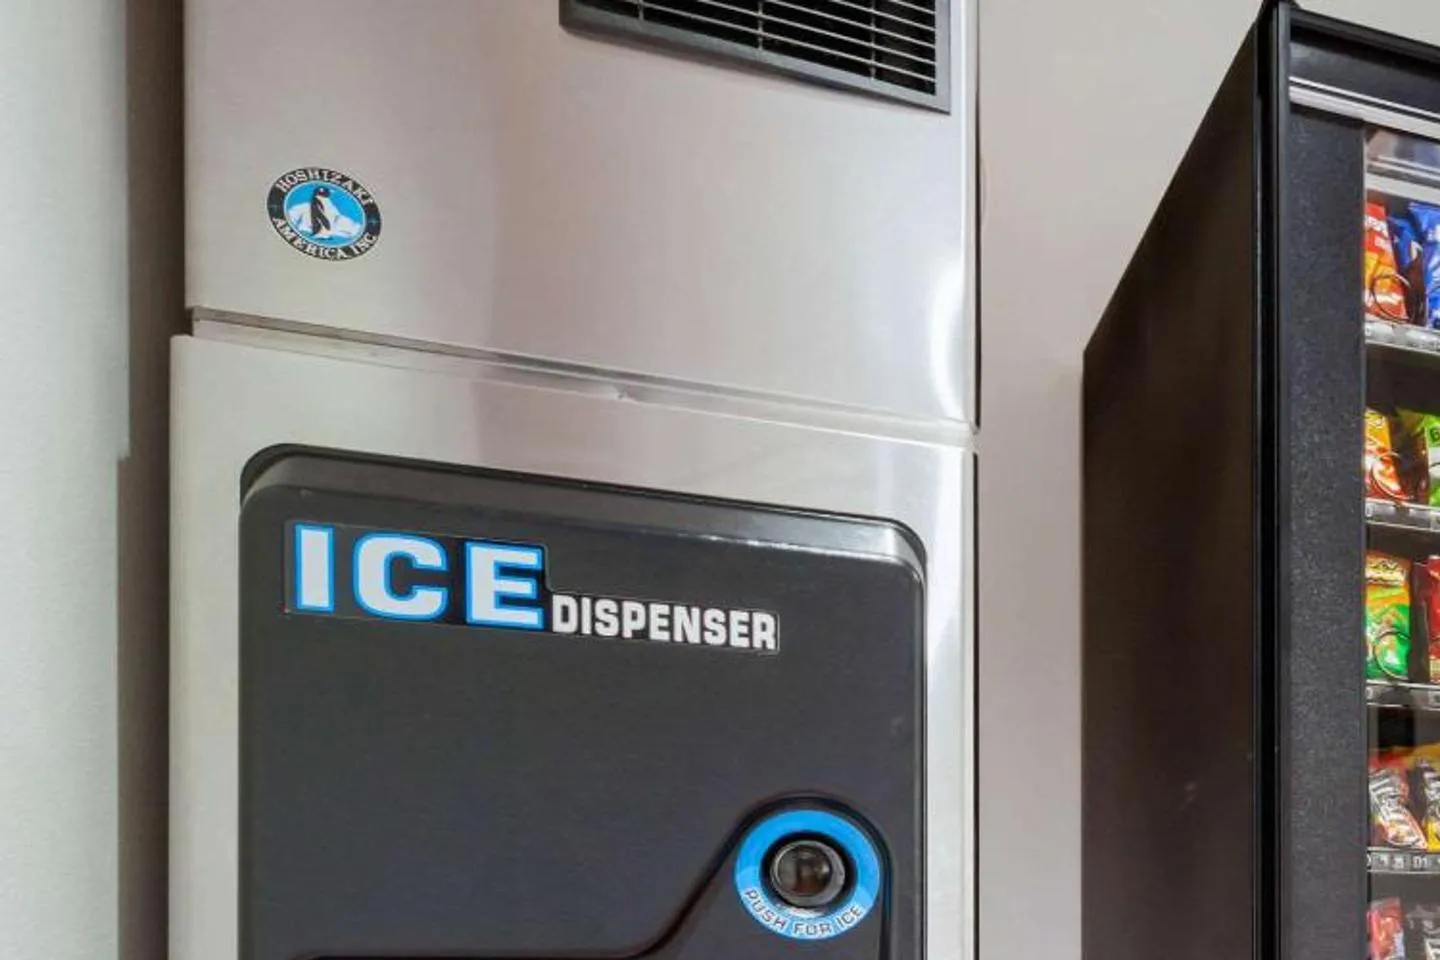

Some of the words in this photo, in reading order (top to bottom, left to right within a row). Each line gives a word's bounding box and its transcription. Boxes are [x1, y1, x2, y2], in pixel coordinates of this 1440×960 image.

[275, 167, 374, 206] HOSHIZAKI
[271, 217, 349, 259] AMERICA
[295, 524, 545, 629] ICE
[554, 594, 776, 651] DISPENSER
[745, 889, 786, 929] PUSH
[793, 922, 831, 935] FOR
[836, 905, 862, 928] ICE
